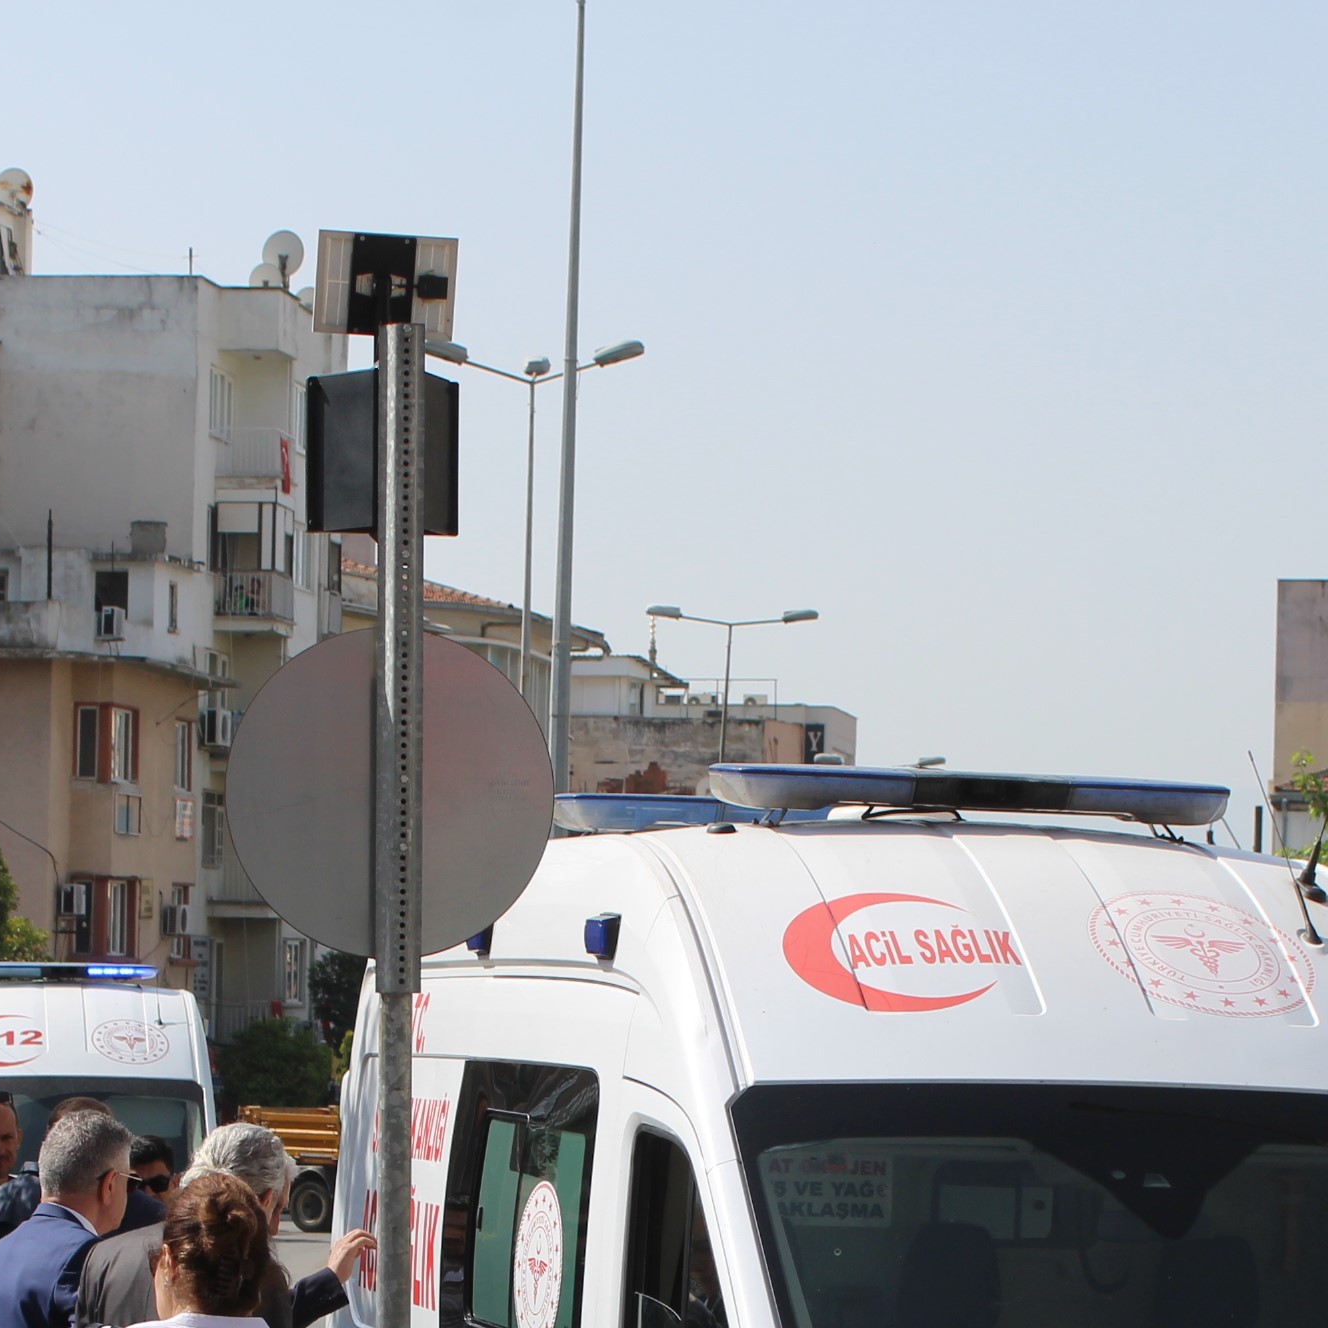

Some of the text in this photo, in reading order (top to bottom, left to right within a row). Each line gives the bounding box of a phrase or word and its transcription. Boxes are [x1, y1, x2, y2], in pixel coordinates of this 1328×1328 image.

[913, 924, 1023, 966] SAĞLIK
[794, 1181, 824, 1196] VE
[777, 1202, 885, 1219] AKLAŞMA
